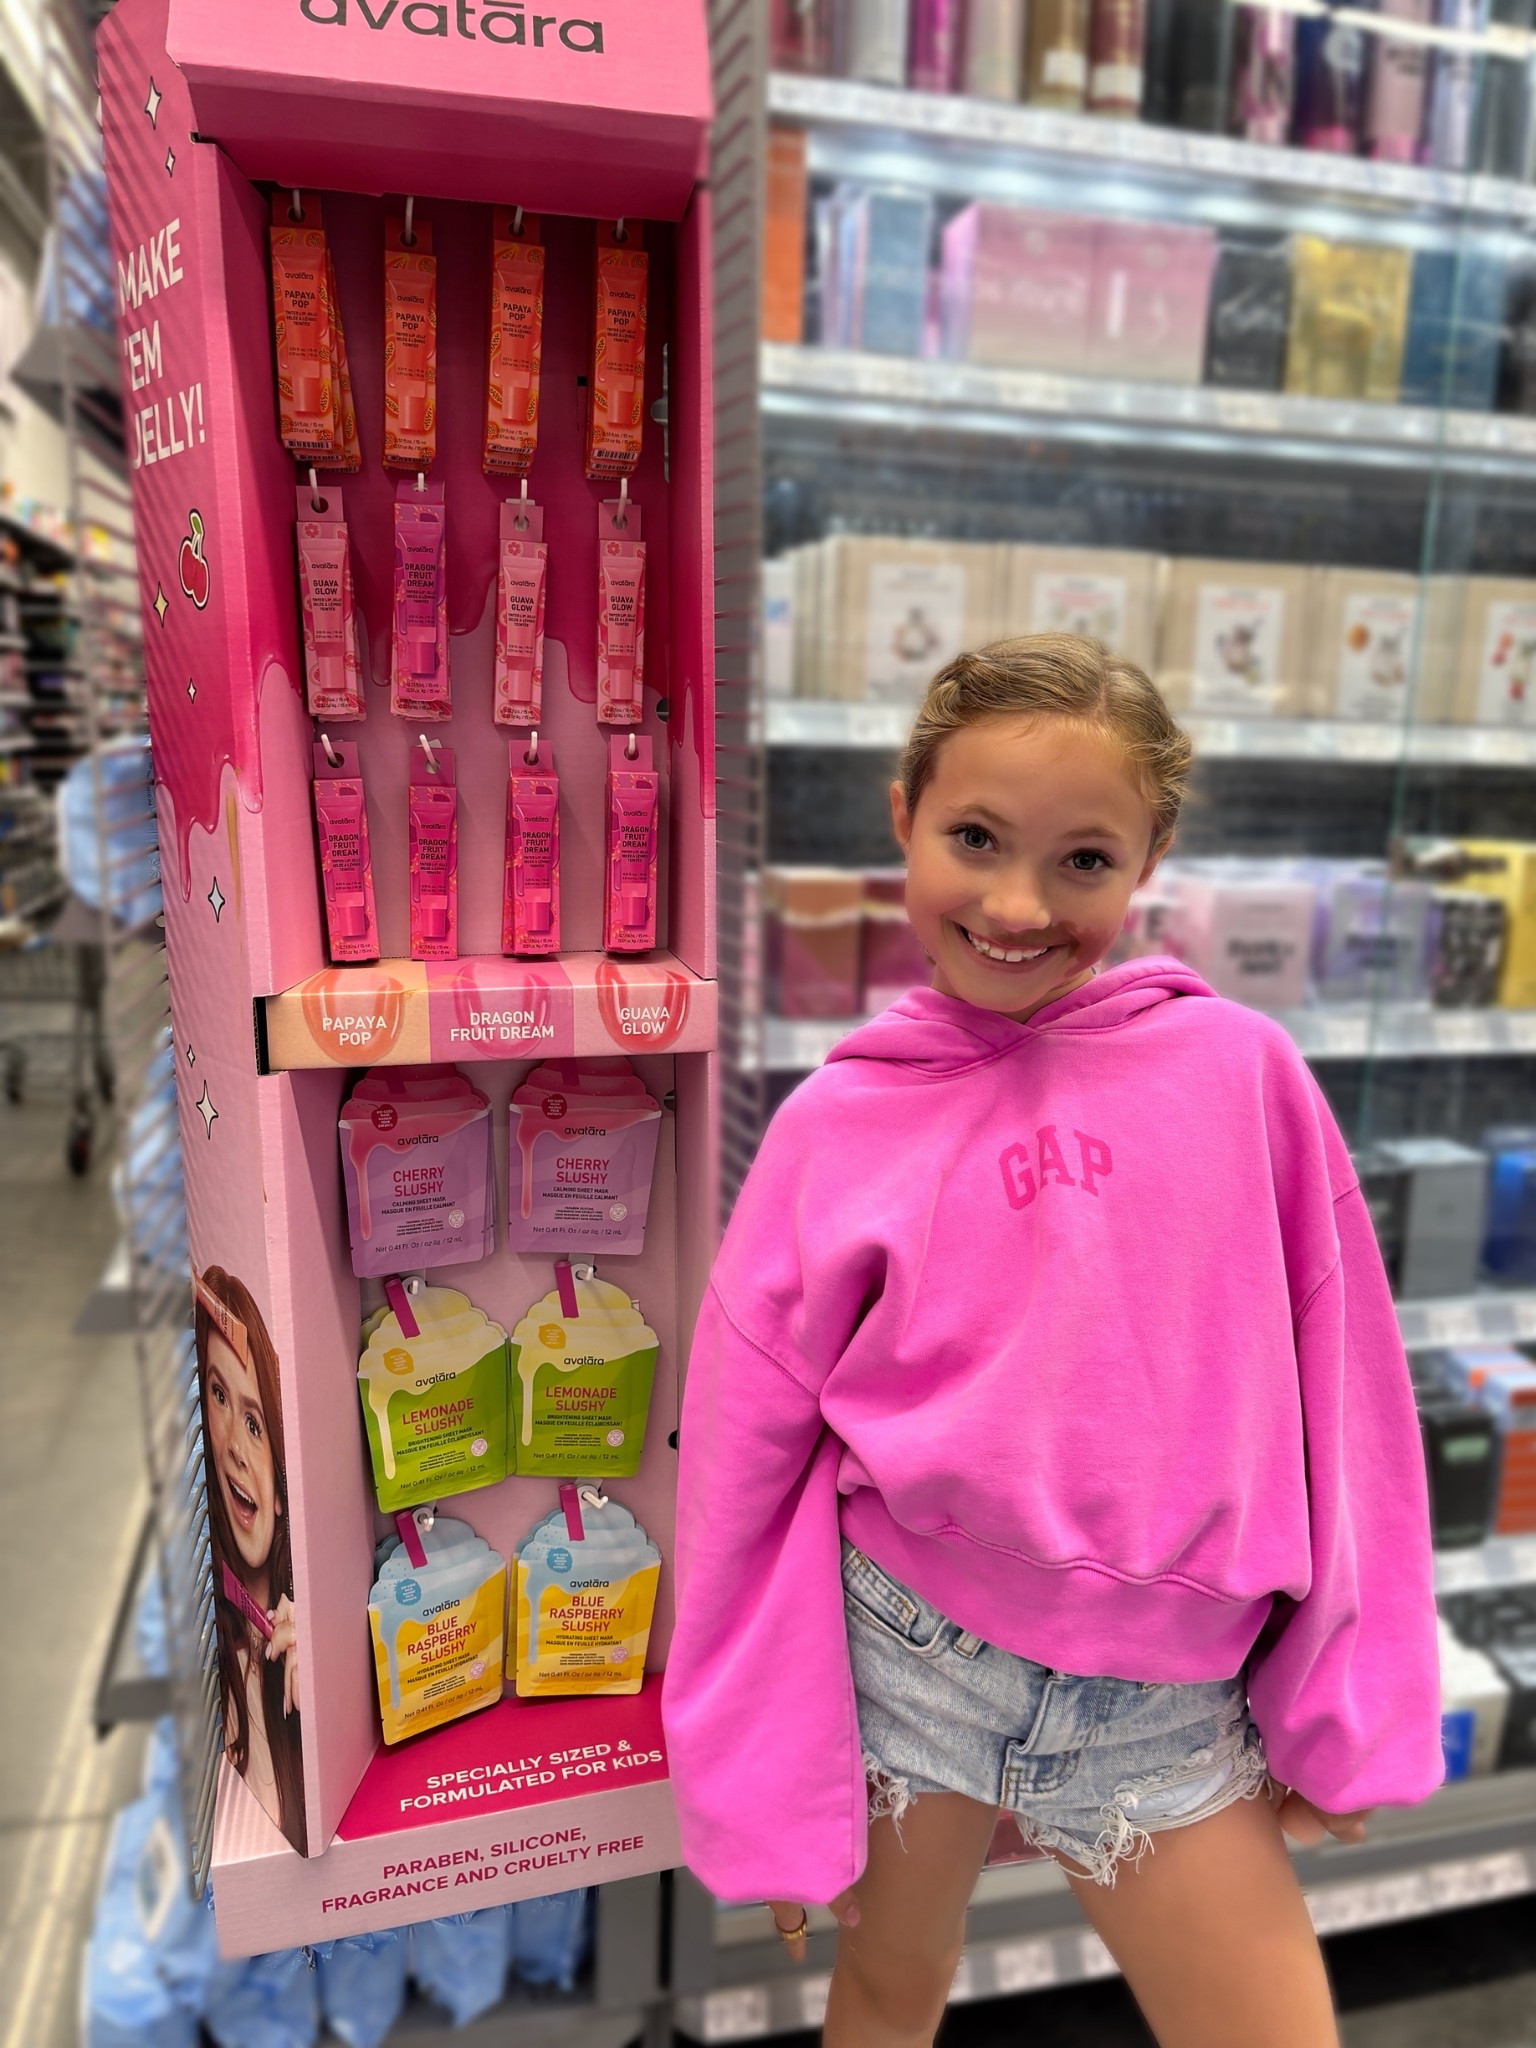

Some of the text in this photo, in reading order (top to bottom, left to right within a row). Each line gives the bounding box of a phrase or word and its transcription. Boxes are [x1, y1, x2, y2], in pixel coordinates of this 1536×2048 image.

[118, 218, 183, 316] MAKE
[285, 291, 315, 301] PAPAYA
[292, 299, 309, 308] POP
[503, 303, 532, 314] PAPAYA
[396, 313, 425, 323] PAPAYA
[509, 312, 525, 321] POP
[608, 309, 636, 318] PAPAYA
[402, 321, 418, 330] POP
[614, 317, 630, 326] POP
[132, 383, 205, 470] JELLY!
[405, 563, 436, 571] DRAGON
[511, 596, 534, 604] GUAVA
[612, 603, 632, 611] GLOW
[470, 1011, 534, 1026] DRAGON
[620, 1007, 670, 1021] GUAVA
[323, 1015, 387, 1031] PAPAYA
[622, 1021, 665, 1035] GLOW
[339, 1032, 371, 1046] POP
[451, 1025, 554, 1042] FRUIT DREAM
[564, 1126, 606, 1136] avatāra
[398, 1134, 438, 1146] avatāra
[556, 1158, 609, 1170] CHERRY
[998, 1124, 1113, 1211] GAP
[393, 1167, 444, 1183] CHERRY
[556, 1171, 608, 1184] SLUSHY
[395, 1181, 444, 1197] SLUSHY
[564, 1356, 604, 1366] avatāra
[415, 1372, 456, 1387] avatāra
[546, 1386, 617, 1399] LEMONADE
[403, 1398, 474, 1425] LEMONADE
[556, 1400, 605, 1412] SLUSHY
[415, 1414, 464, 1436] SLUSHY
[570, 1579, 609, 1588] avatāra
[423, 1599, 460, 1617] avatāra
[572, 1596, 604, 1607] BLUE
[550, 1608, 624, 1620] RASPBERRY
[427, 1616, 458, 1636] BLUE
[562, 1621, 610, 1632] SLUSHY
[407, 1622, 477, 1656] RASPBERRY
[421, 1640, 466, 1665] SLUSHY
[427, 1740, 631, 1789] SPECIALLY SIZED &
[400, 1749, 663, 1812] FORMULATED FOR KIDS
[383, 1827, 587, 1880] PARABEN, SILICONE,
[321, 1835, 645, 1914] FRAGRANCE AND CRUELTY FREE
